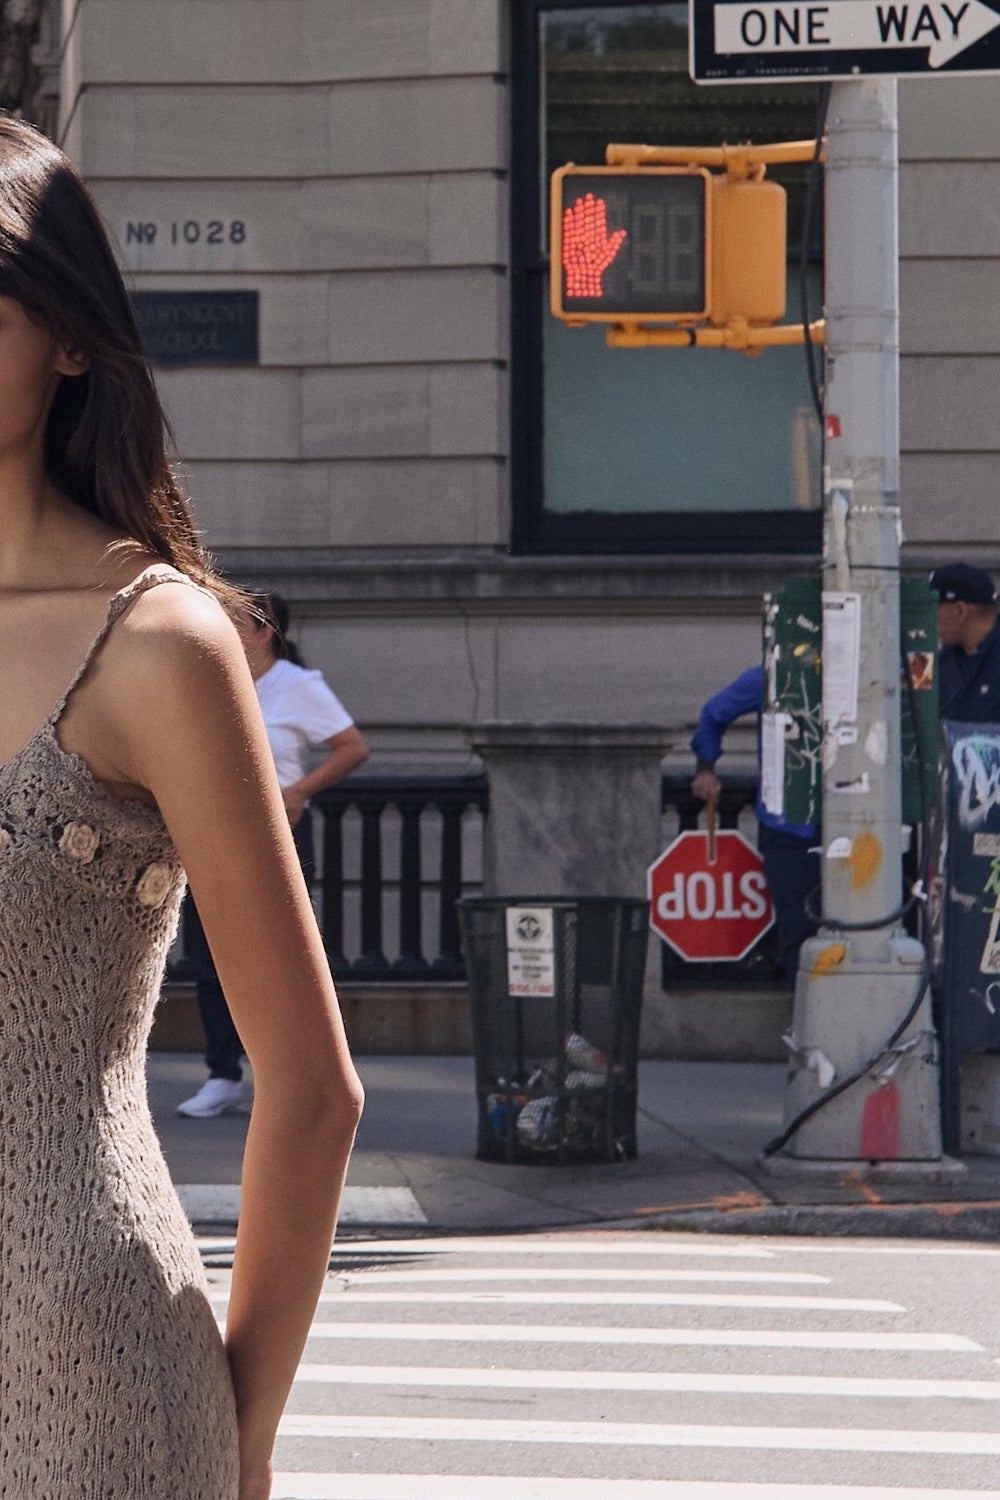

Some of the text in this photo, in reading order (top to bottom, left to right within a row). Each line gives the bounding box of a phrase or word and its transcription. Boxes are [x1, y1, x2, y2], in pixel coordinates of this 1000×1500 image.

[741, 3, 970, 46] ONE WAY
[171, 220, 246, 244] 1028
[657, 870, 767, 920] STOP
